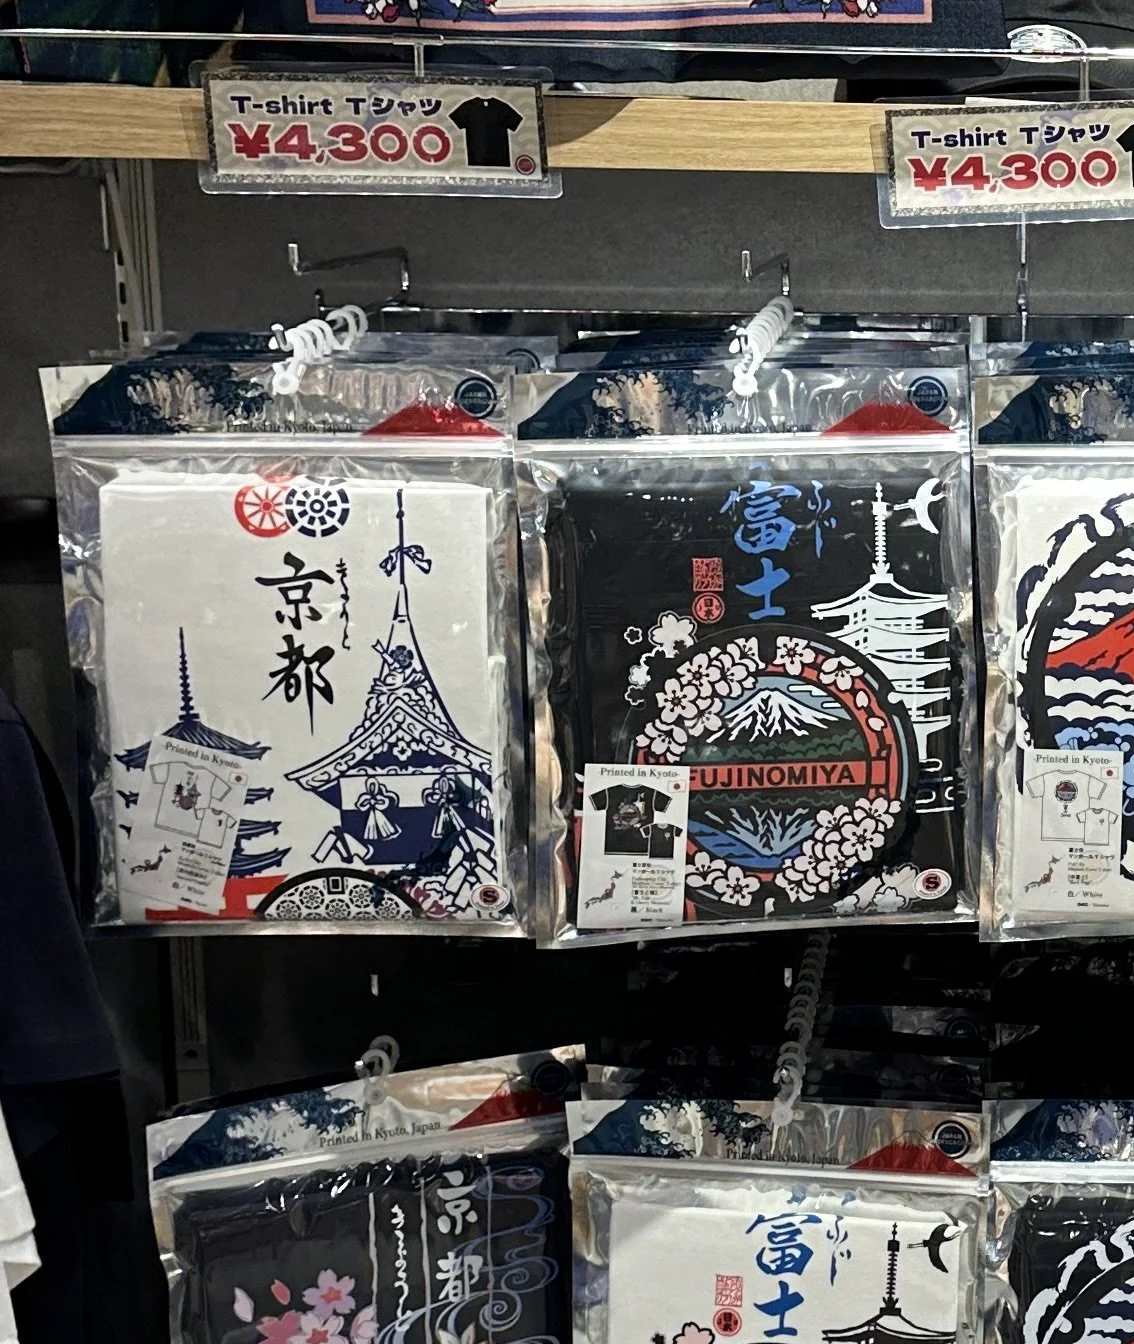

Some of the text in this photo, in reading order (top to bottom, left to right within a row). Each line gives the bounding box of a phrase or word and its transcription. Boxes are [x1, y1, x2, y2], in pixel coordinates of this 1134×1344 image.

[230, 94, 444, 117] T-shirt Tシャツ
[226, 122, 453, 164] ¥4,300
[910, 123, 1111, 149] T-shirt Tシャツ
[907, 150, 1118, 194] ¥4,300
[720, 479, 802, 621] 富士
[254, 551, 335, 735] 京都
[689, 764, 856, 790] FUJINOMIYA
[435, 1169, 484, 1304] 京都
[745, 1212, 823, 1338] 富士
